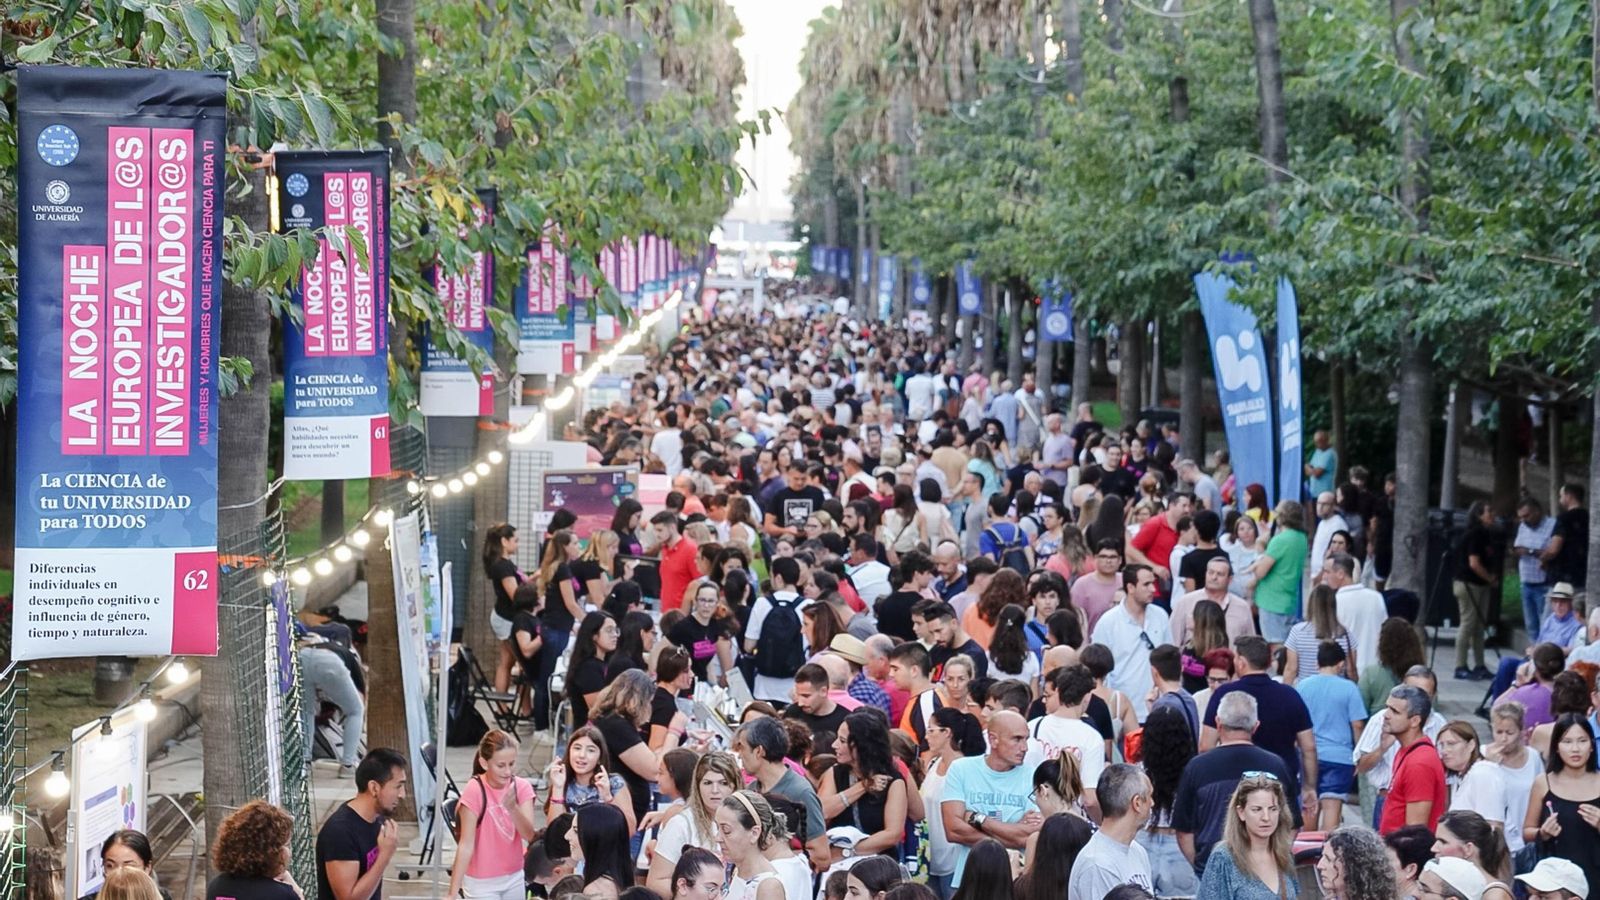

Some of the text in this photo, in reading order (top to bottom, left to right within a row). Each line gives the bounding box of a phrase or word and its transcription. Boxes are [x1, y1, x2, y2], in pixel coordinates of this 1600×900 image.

[328, 177, 345, 220] L@S
[32, 205, 83, 214] UNIVERSIDAD
[35, 212, 80, 222] DE ALMERÍA
[112, 136, 144, 446] EUROPEA DE L@S
[155, 137, 187, 447] INVESTIGADOR@S
[198, 140, 214, 445] MUJERES Y HOMBRES QUE HACEN CIENCIA PARA TI
[330, 259, 348, 352] EUROPEA
[307, 325, 325, 352] LA
[68, 254, 99, 446] LA NOCHE
[295, 374, 364, 385] La CIENCIA de
[295, 385, 378, 397] tu UNIVERSIDAD
[295, 398, 354, 410] para TODOS
[374, 426, 386, 440] 61
[40, 473, 167, 488] La CIENCIA de
[40, 495, 191, 510] tu UNIVERSIDAD
[39, 514, 146, 533] para TODOS
[29, 562, 97, 574] Diferencias
[28, 579, 118, 590] individuales en
[183, 569, 209, 591] 62
[28, 595, 160, 607] desempeño cognitivo e
[28, 611, 87, 623] influencia
[90, 611, 105, 622] de
[28, 626, 148, 640] tiempo y naturaleza.
